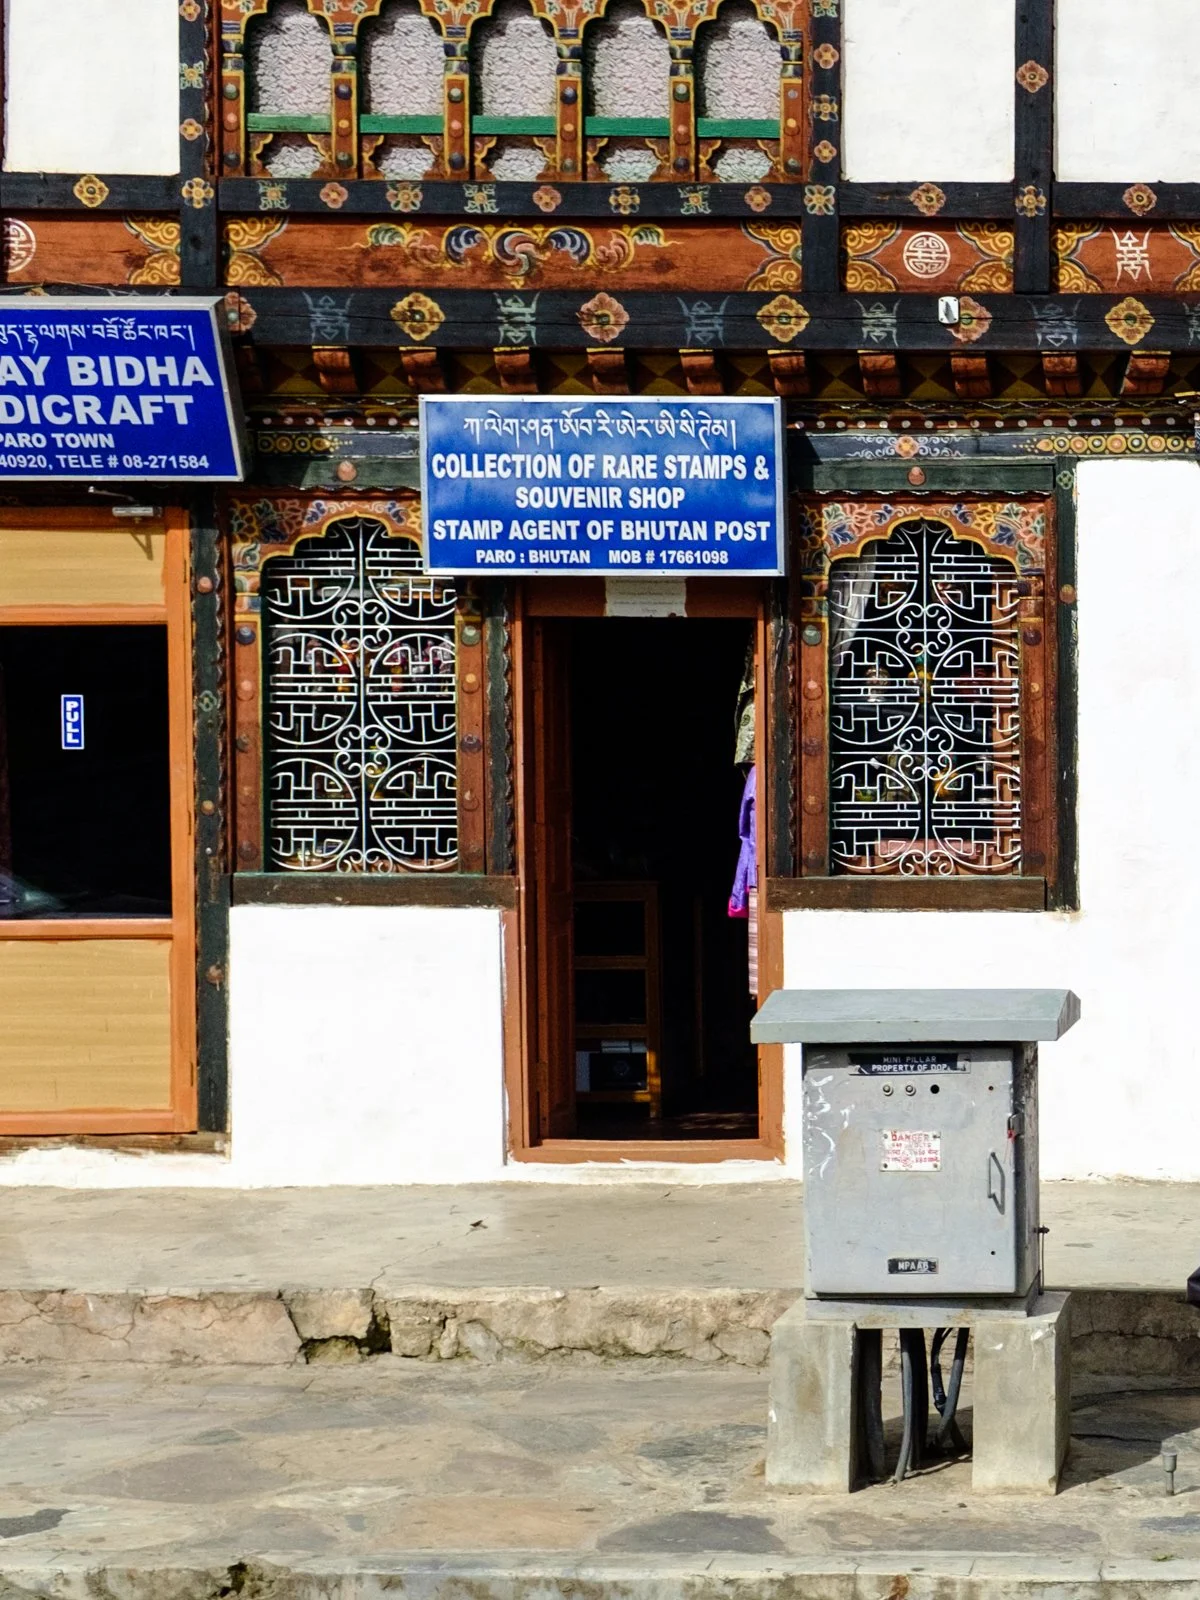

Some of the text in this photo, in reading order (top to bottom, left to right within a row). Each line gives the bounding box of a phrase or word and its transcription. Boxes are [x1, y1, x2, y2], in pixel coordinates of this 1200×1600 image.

[0, 355, 215, 386] AY BIDHA
[0, 394, 194, 425] DICRAFT
[51, 433, 115, 448] TOWN
[55, 454, 104, 468] TELE
[107, 455, 119, 468] #
[122, 455, 210, 469] 08-271584
[431, 453, 770, 480] COLLECTION OF RARE STAMPS &
[515, 486, 686, 509] SOUVENIR SHOP
[433, 519, 771, 541] STAMP AGENT OF BHUTAN POST
[476, 549, 516, 564] PARO
[528, 549, 591, 564] BHUTAN
[608, 549, 642, 564] MOB
[645, 550, 655, 564] #
[659, 550, 729, 564] 17661098
[66, 701, 80, 743] PULL
[871, 1064, 914, 1072] PROPERTY
